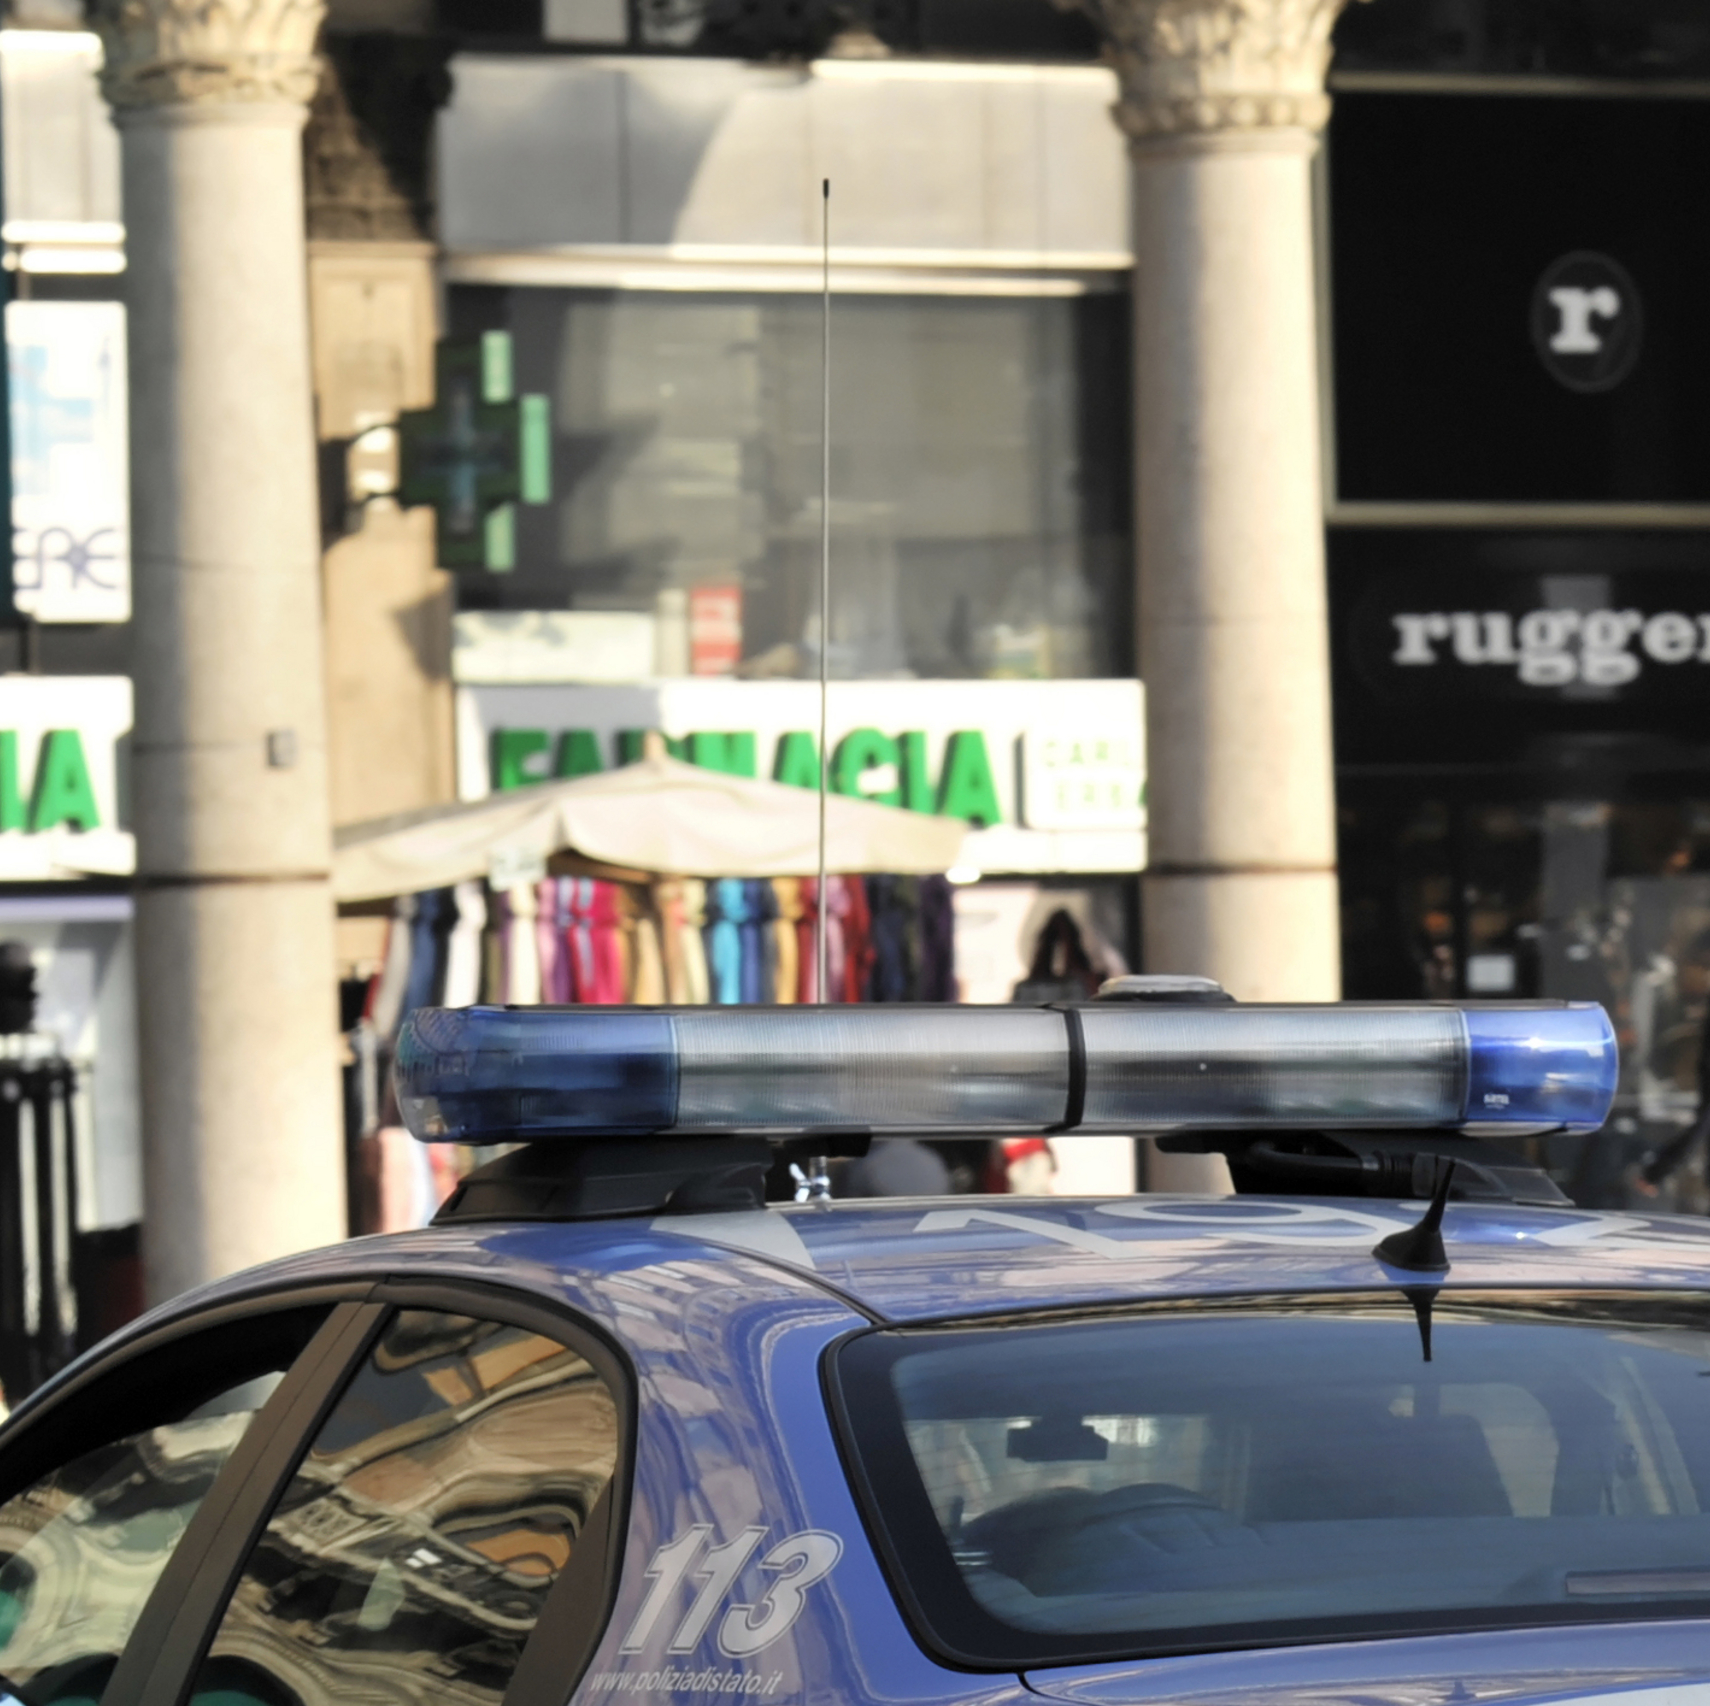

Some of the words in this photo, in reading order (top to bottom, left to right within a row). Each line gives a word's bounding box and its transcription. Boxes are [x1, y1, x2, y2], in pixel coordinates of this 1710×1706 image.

[1548, 284, 1621, 354] r
[617, 1523, 844, 1659] 113
[590, 1665, 784, 1695] www.poliziadistato.it
